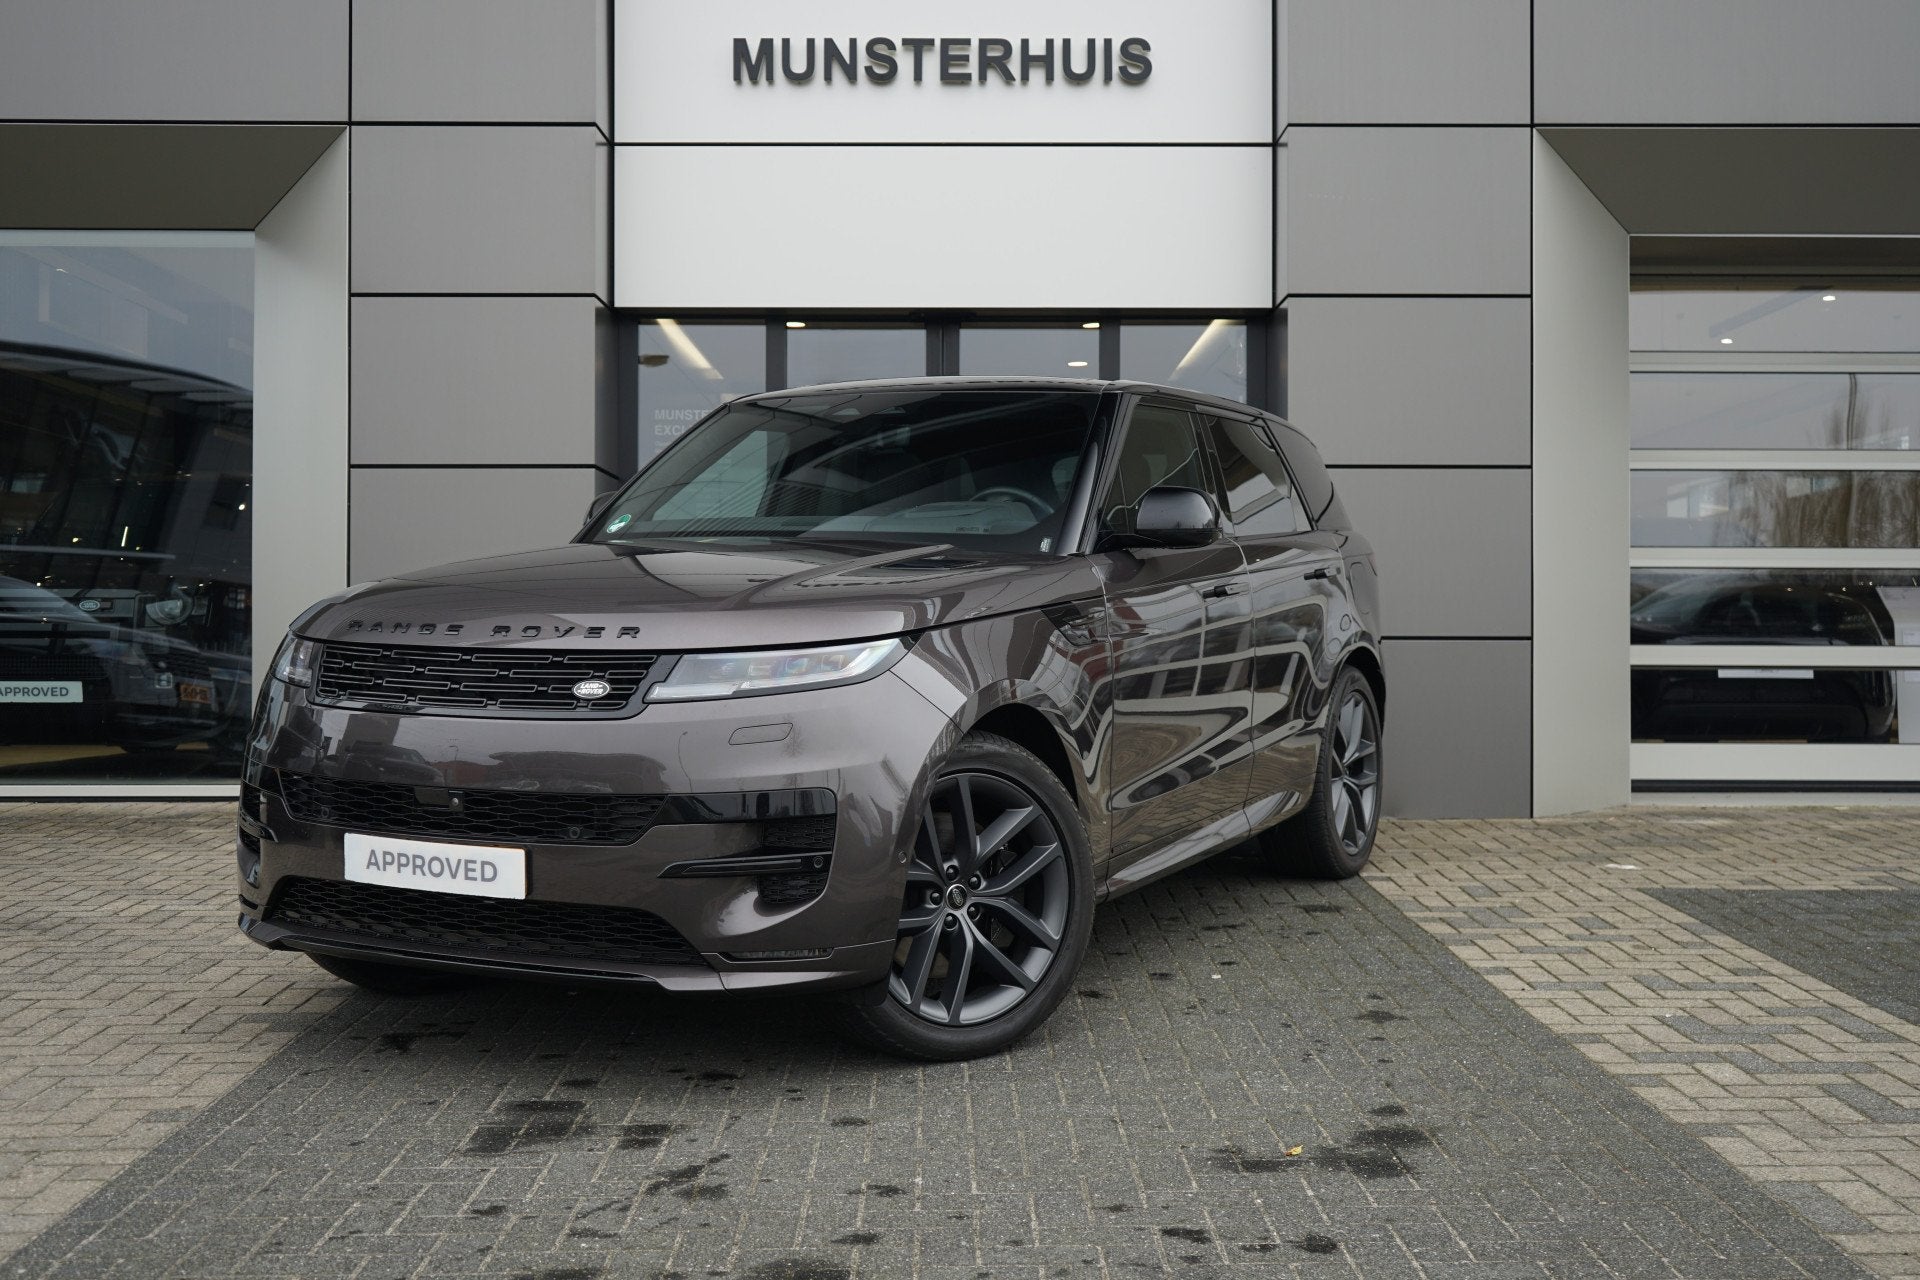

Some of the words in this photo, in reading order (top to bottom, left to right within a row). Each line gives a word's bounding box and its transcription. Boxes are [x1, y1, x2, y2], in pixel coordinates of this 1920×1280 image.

[732, 37, 1153, 84] MUNSTERHUIS
[654, 409, 713, 421] MUNSTE
[346, 620, 465, 637] RANGE
[489, 625, 641, 639] ROVER
[366, 849, 498, 883] APPROVED
